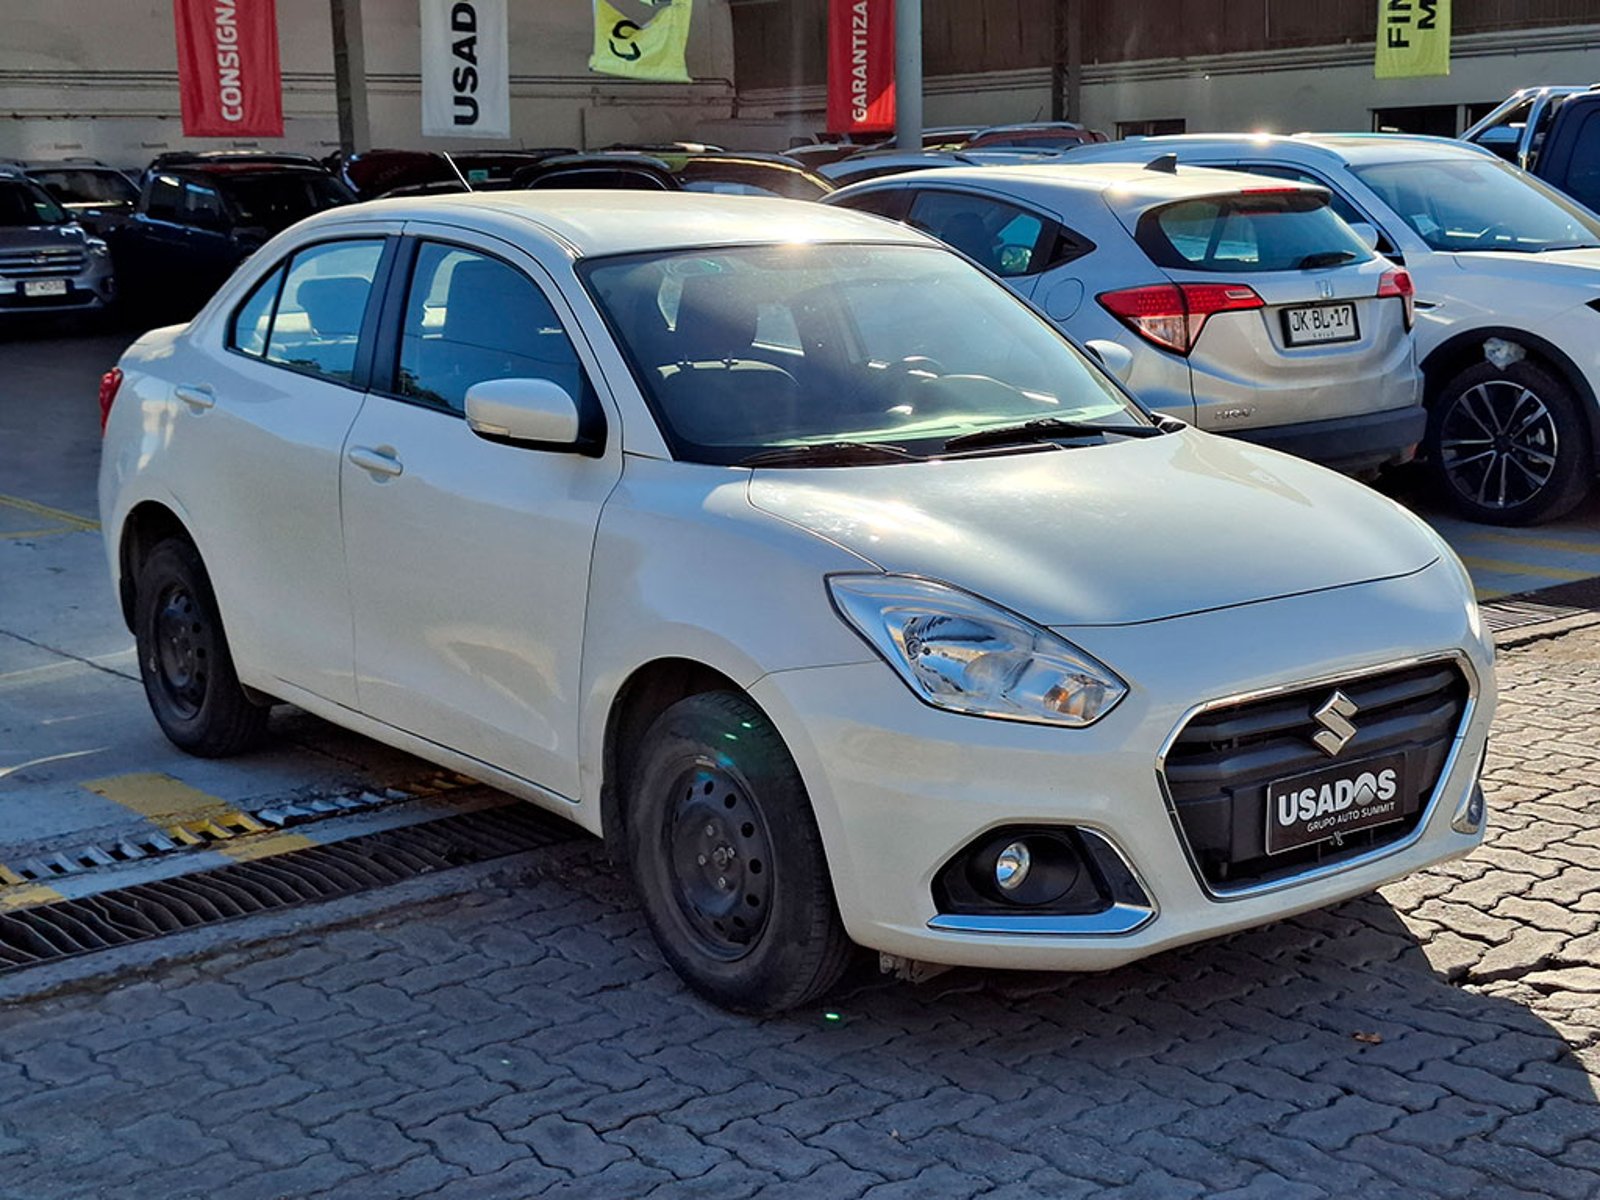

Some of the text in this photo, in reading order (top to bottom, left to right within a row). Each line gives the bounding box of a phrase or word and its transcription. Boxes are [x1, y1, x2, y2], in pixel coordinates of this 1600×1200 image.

[852, 0, 868, 122] GARANTIZA
[1278, 769, 1396, 826] USADOS
[1307, 802, 1395, 832] GRUPO AUTO SUMMIT
